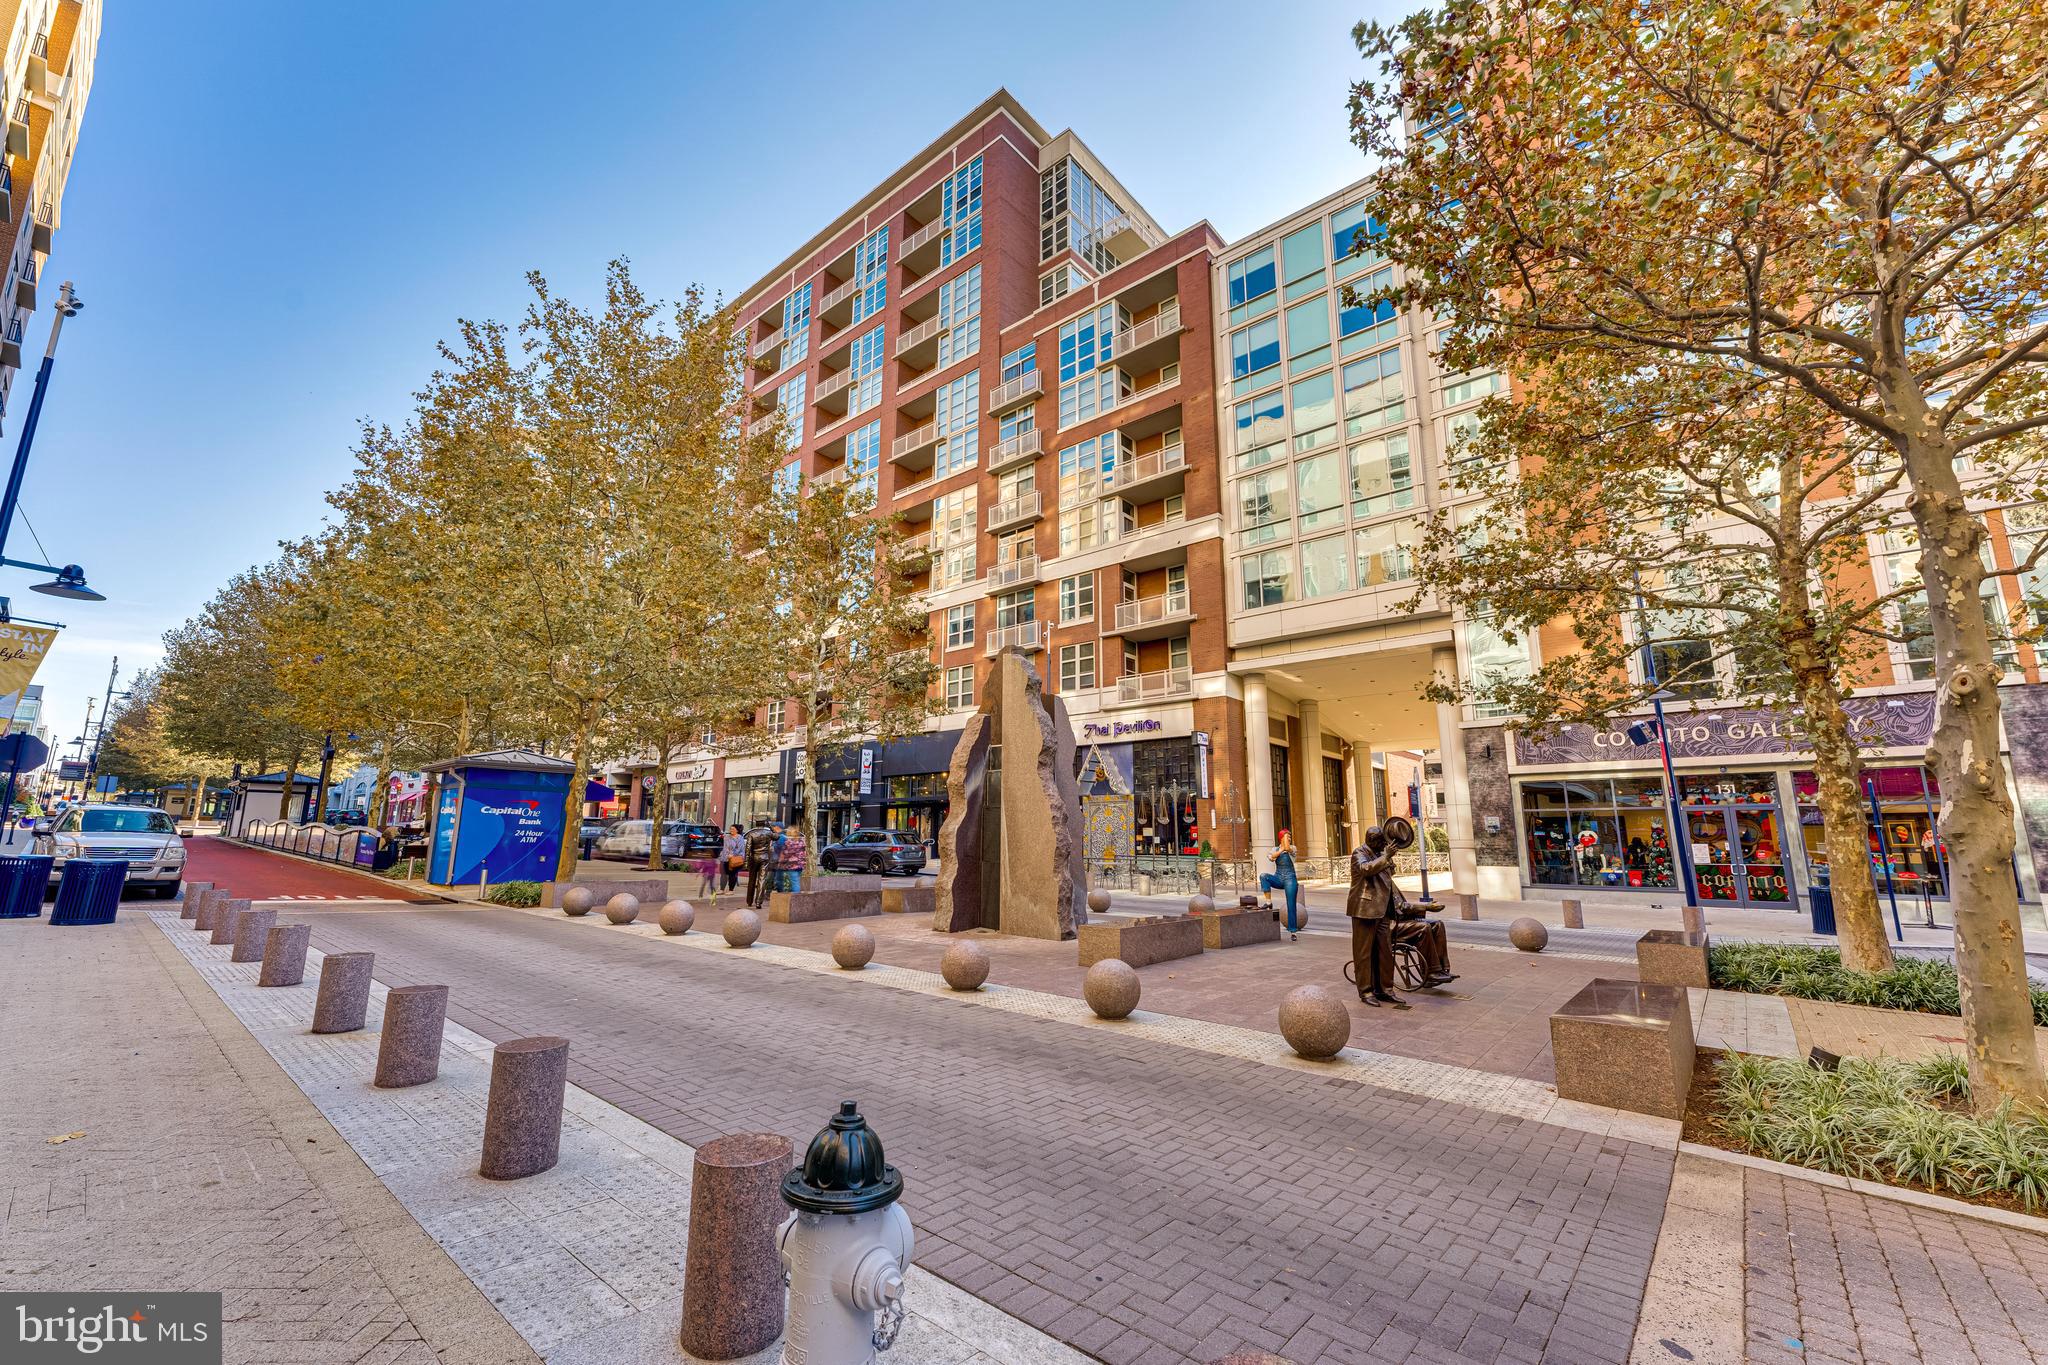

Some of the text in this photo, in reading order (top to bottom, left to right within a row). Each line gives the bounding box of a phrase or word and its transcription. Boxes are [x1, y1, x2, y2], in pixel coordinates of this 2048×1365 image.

[0, 628, 48, 643] STAY
[0, 648, 29, 661] tyle.
[23, 642, 45, 654] IN
[1084, 723, 1110, 739] Thai
[1593, 715, 1863, 748] COTO GALLY
[1715, 784, 1736, 795] 131
[520, 836, 537, 844] ATM
[1701, 874, 1786, 889] CORNTO
